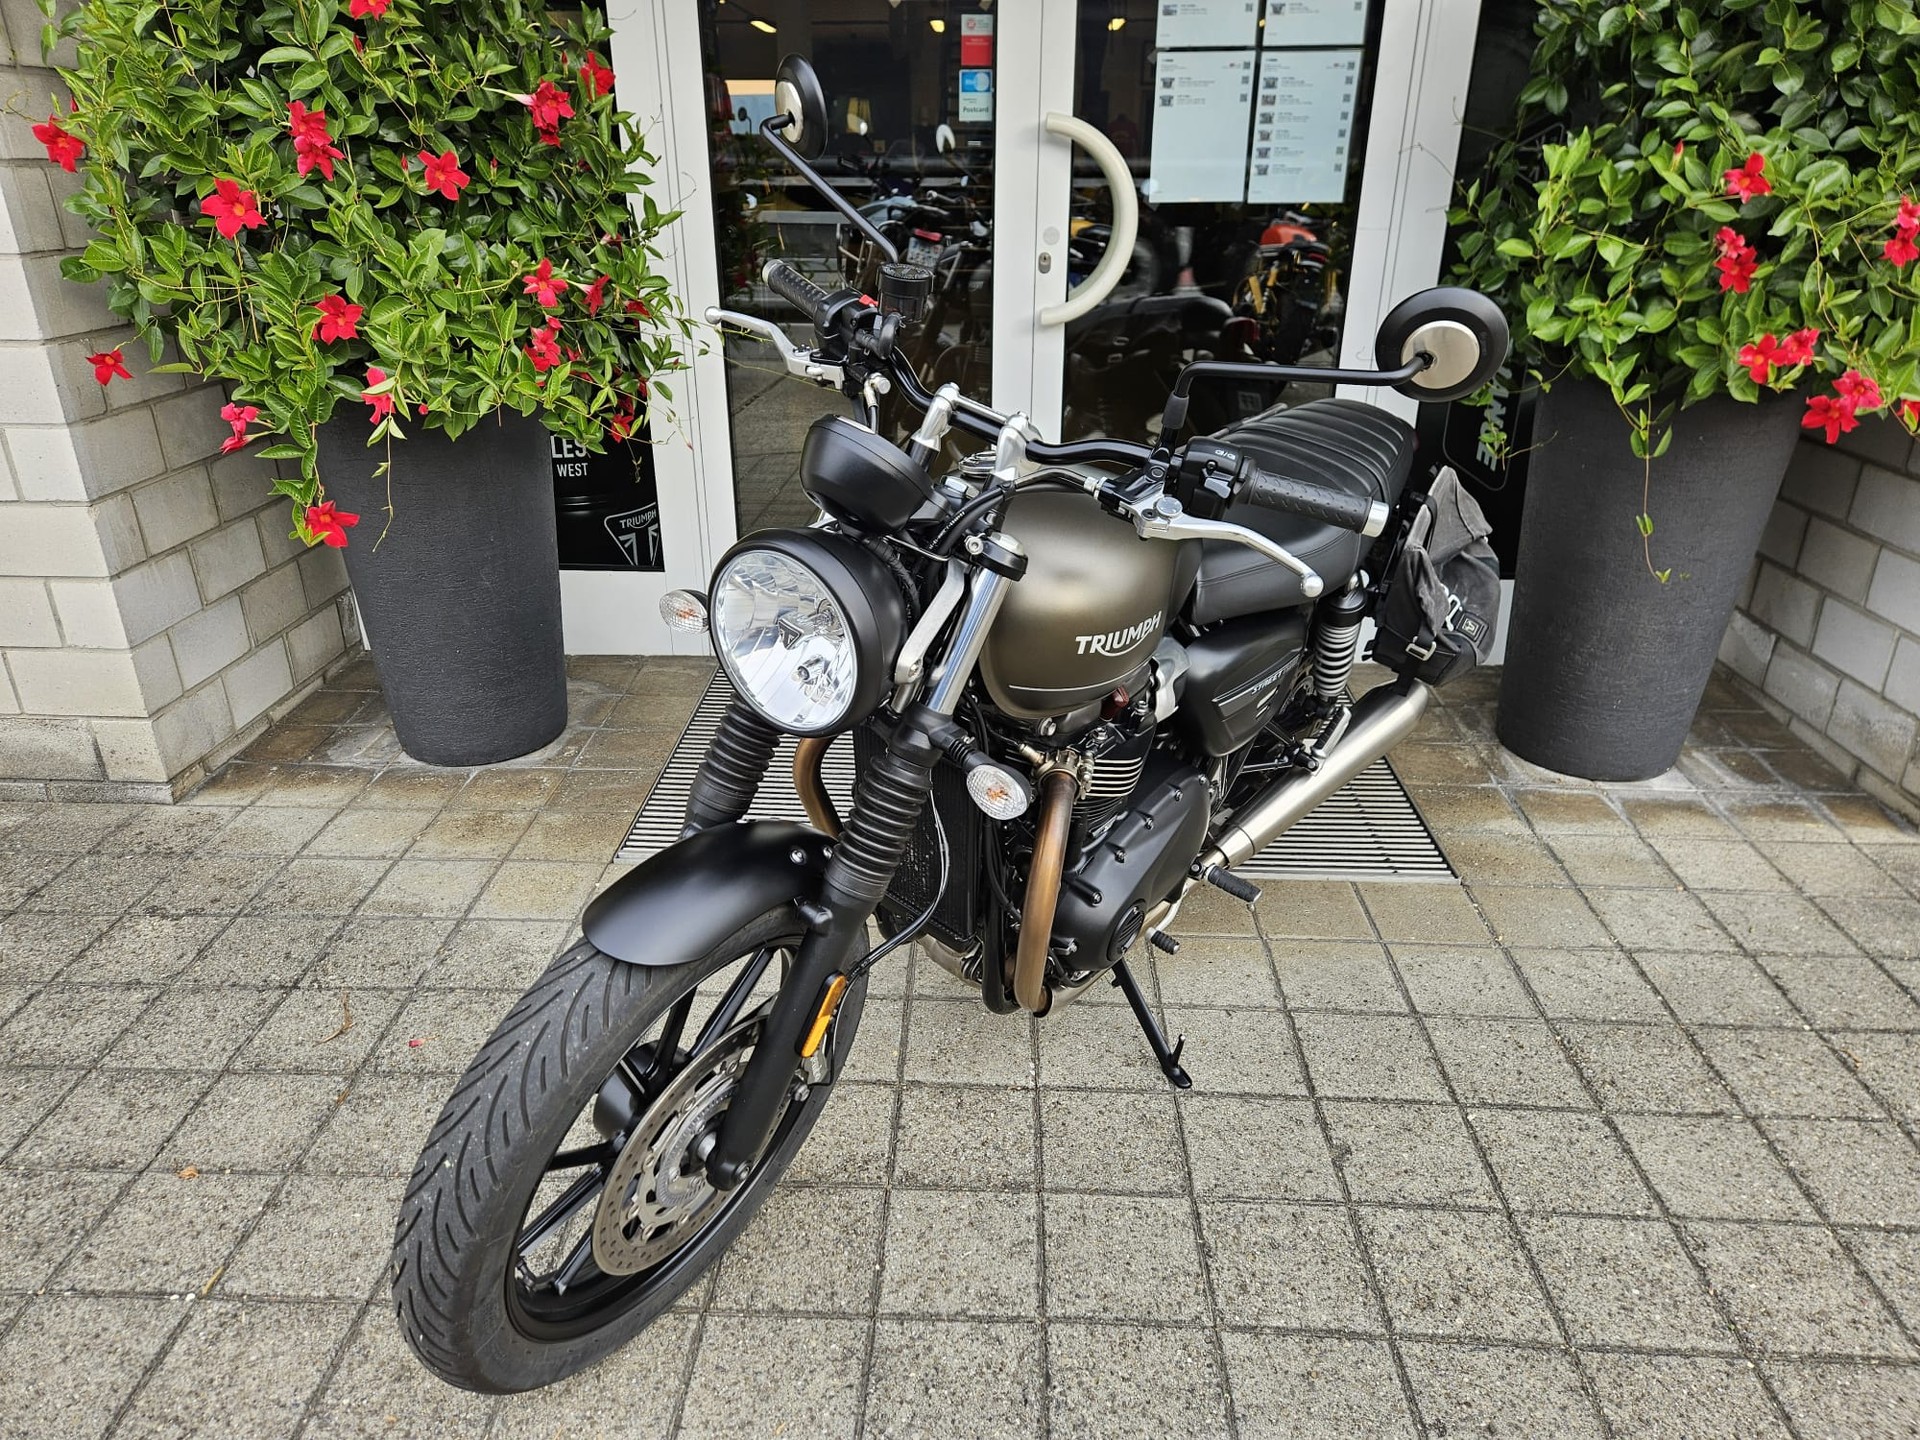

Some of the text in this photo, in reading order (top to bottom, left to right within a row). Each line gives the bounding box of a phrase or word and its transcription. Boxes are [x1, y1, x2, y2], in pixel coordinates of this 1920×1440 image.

[556, 462, 588, 477] WEST
[620, 510, 656, 528] TRIUMPH
[1075, 611, 1162, 657] TRIUMPH
[1251, 669, 1285, 695] STREET
